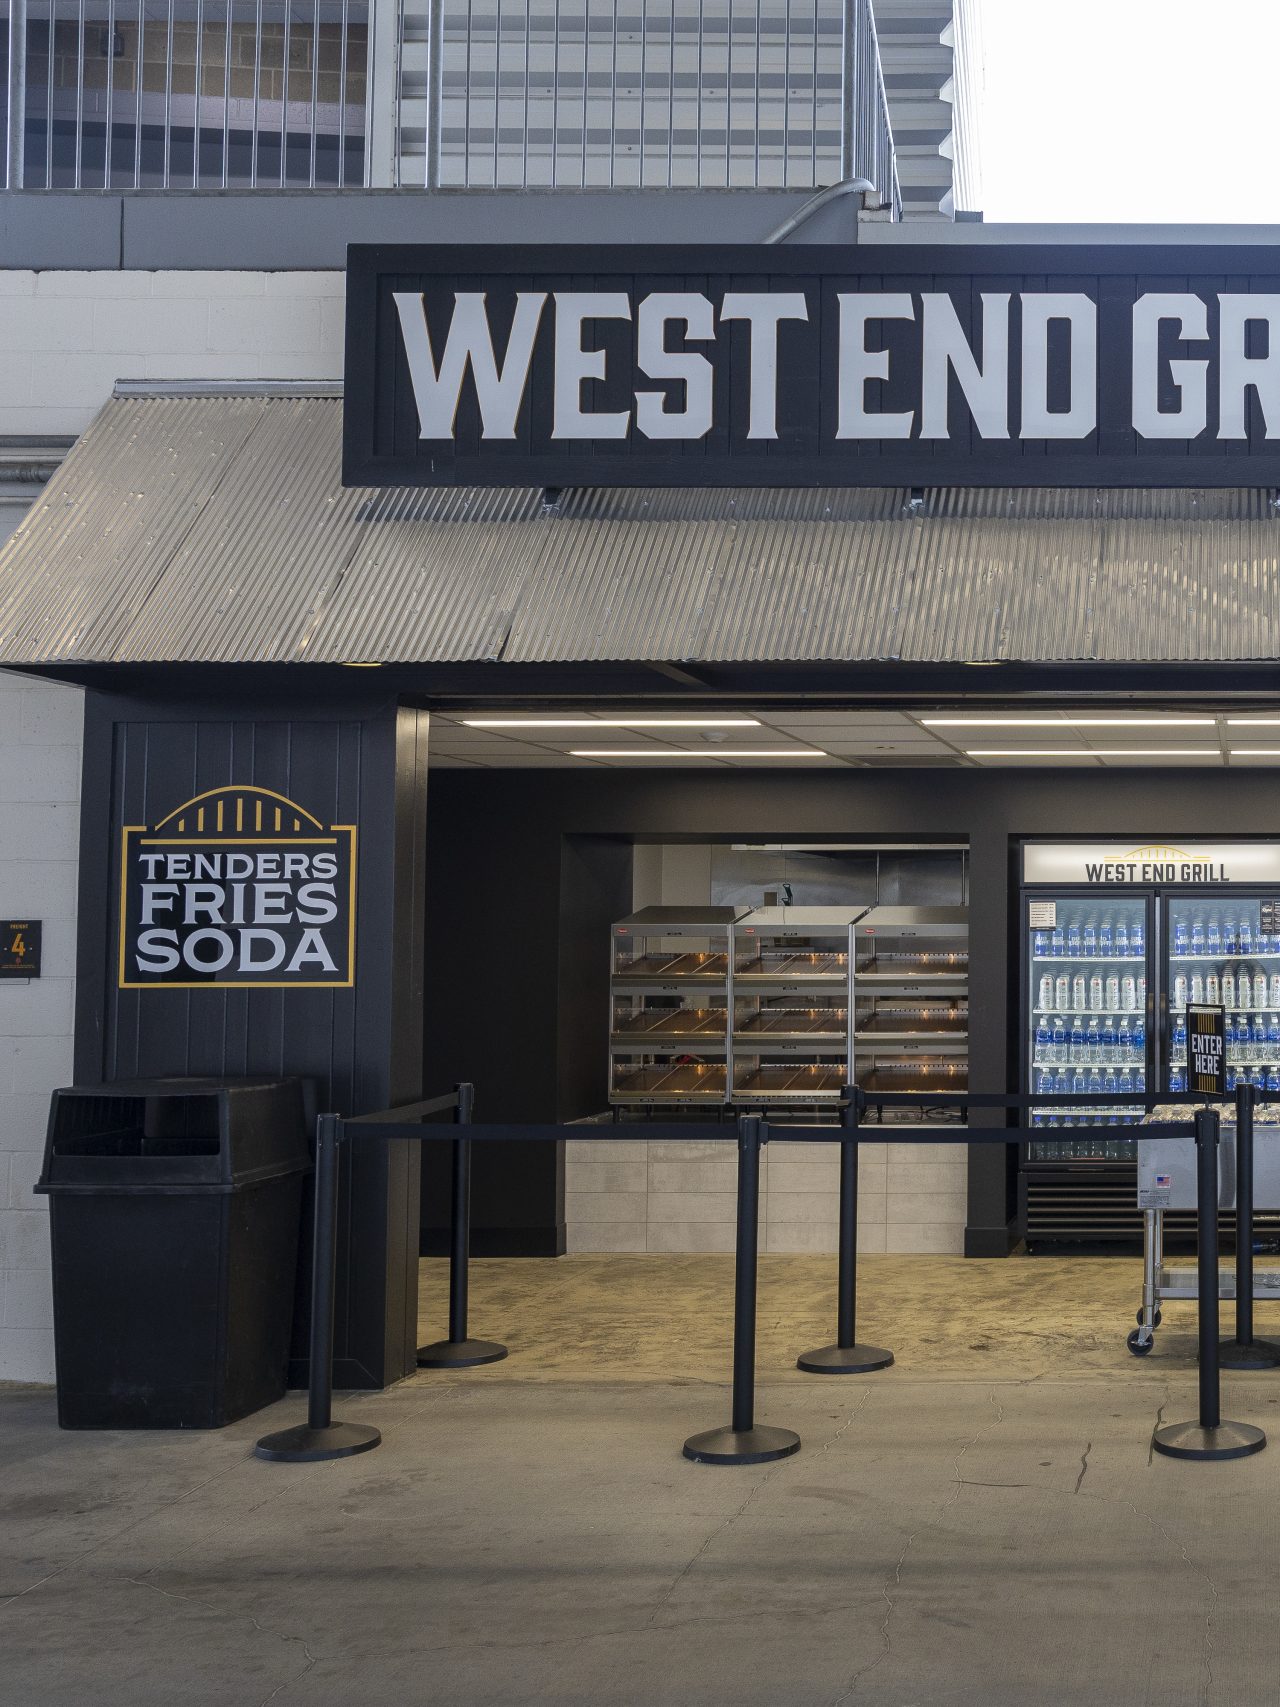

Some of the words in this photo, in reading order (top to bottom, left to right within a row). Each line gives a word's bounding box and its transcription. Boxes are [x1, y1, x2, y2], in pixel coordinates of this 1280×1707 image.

[392, 293, 808, 440] WEST
[835, 293, 1097, 440] END
[138, 852, 338, 880] TENDERS
[1085, 863, 1137, 882] WEST
[1142, 863, 1176, 882] END
[1181, 863, 1230, 882] GRILL
[139, 882, 338, 925] FRIES
[12, 933, 26, 957] 4
[135, 927, 339, 973] SODA
[1191, 1033, 1223, 1055] ENTER
[1195, 1053, 1220, 1075] HERE
